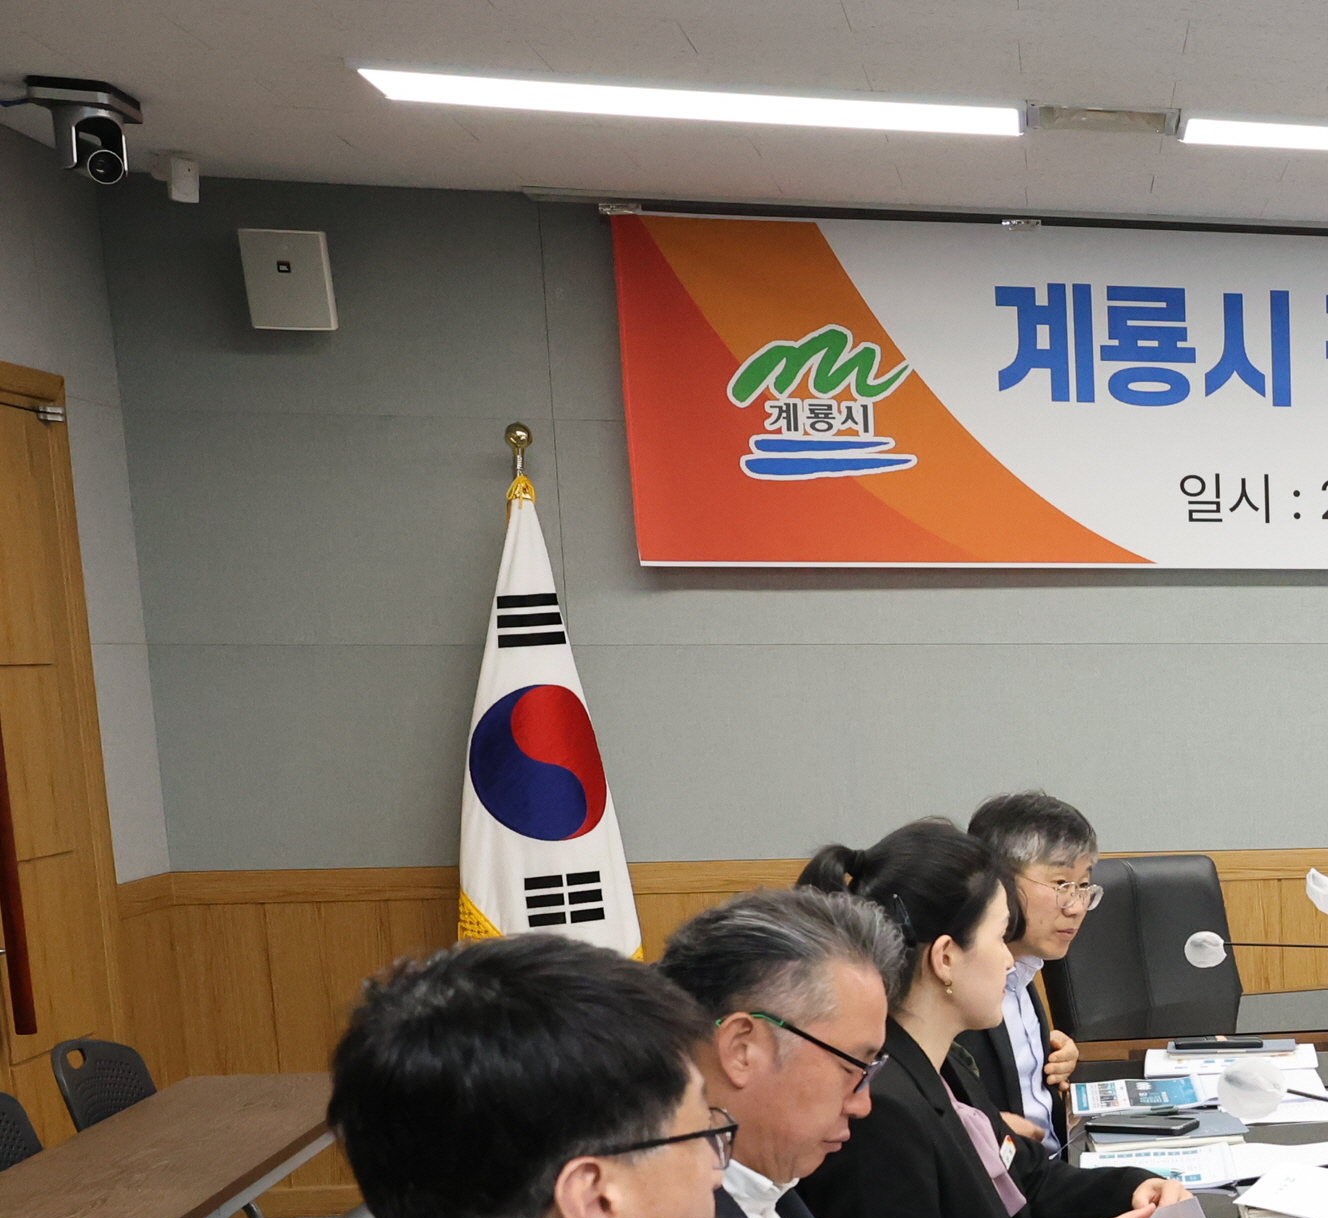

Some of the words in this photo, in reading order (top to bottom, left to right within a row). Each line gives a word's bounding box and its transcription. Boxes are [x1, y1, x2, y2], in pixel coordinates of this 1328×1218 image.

[995, 283, 1292, 407] 계룡시
[769, 402, 869, 433] 계룡시
[1179, 473, 1270, 524] 일시
